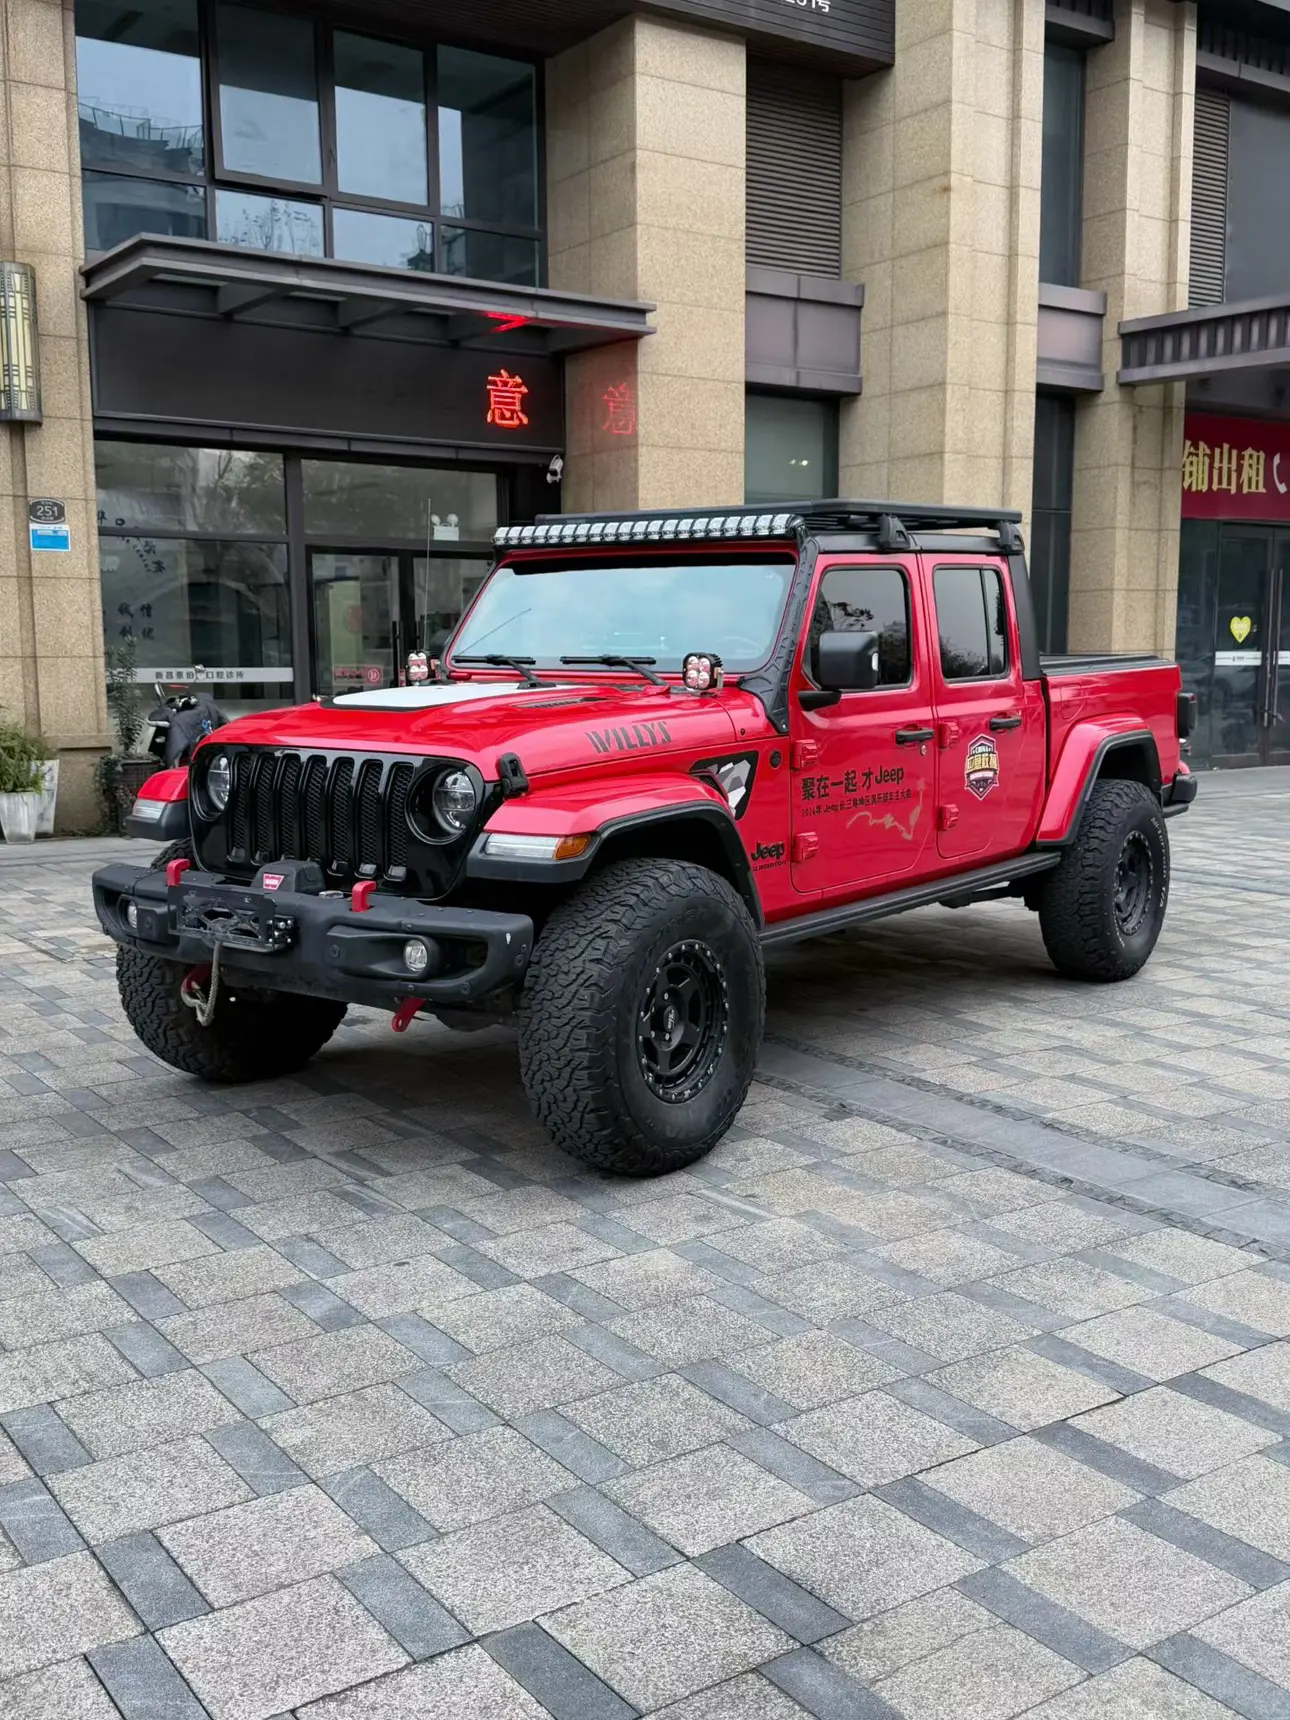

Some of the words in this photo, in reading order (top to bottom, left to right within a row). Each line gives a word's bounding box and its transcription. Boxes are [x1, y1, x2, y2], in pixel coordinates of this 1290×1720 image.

[486, 368, 529, 429] 意
[1182, 439, 1267, 495] 铺出租
[36, 505, 59, 517] 251
[584, 720, 672, 754] WILLYS
[802, 769, 858, 801] 聚在一起
[750, 840, 786, 861] Jeep
